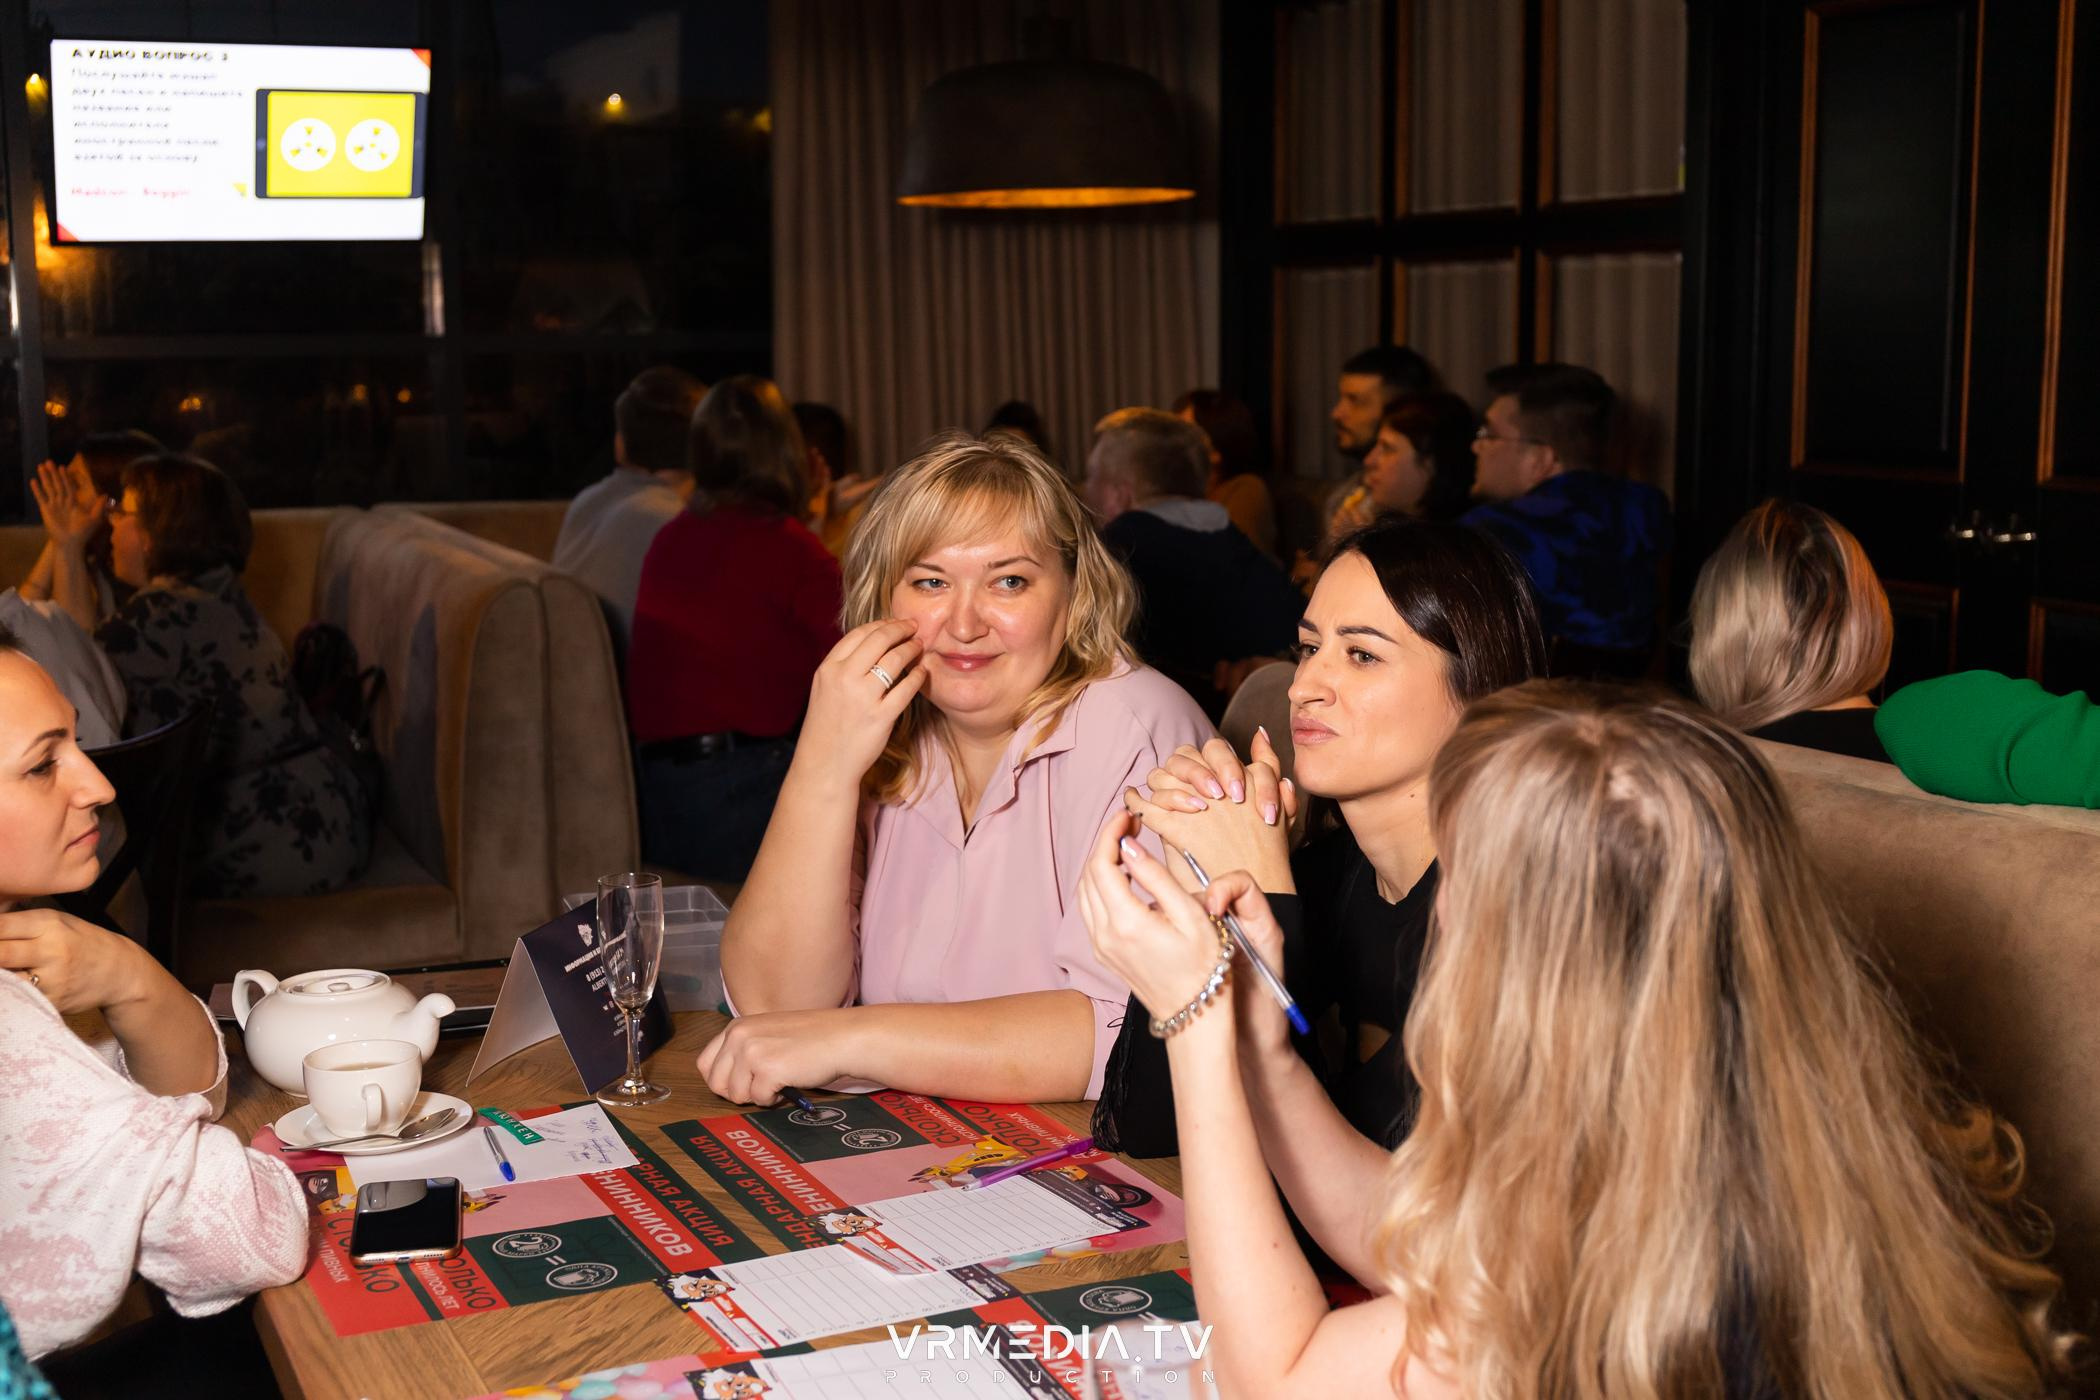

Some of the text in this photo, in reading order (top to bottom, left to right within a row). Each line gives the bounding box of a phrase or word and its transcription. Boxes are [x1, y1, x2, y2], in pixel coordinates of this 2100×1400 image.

[690, 1135, 748, 1178] АКЦИЯ
[725, 1129, 835, 1212] ЕНИННИКОВ
[590, 1170, 693, 1257] НИННИКОВ
[669, 1199, 735, 1247] АКЦИЯ
[737, 1179, 825, 1249] ЕНДАРНАЯ
[437, 1255, 497, 1310] ОЛЬКО
